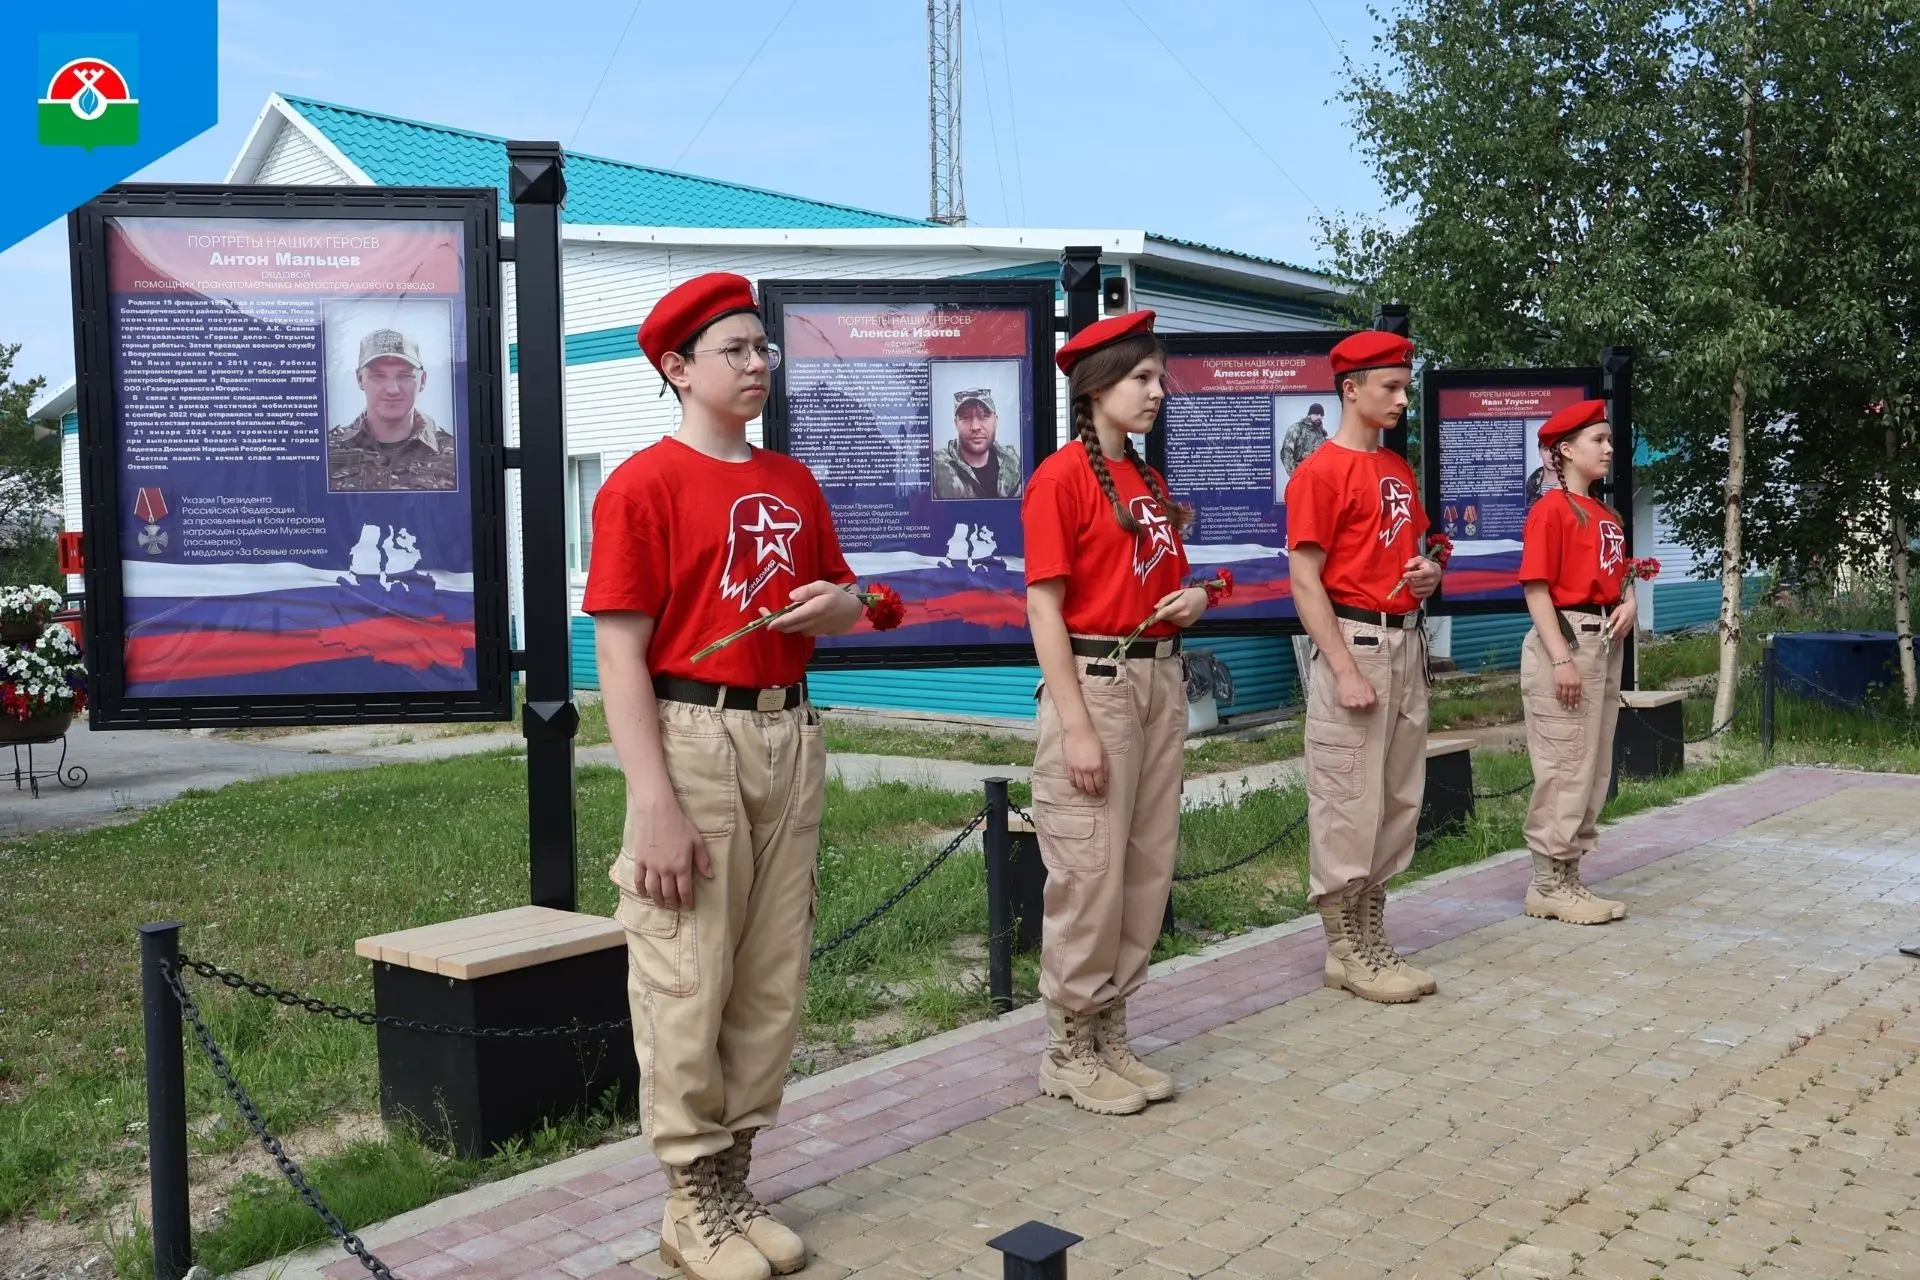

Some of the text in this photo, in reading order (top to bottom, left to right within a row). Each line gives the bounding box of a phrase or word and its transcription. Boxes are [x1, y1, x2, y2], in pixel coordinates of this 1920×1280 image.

[188, 235, 379, 249] ПОРТРЕТЫ НАШИХ ГЕРОЕВ
[210, 252, 360, 268] Антон Мальцев
[261, 270, 311, 281] рядовой
[134, 280, 435, 290] помощник гранатометчика мотострелкового взвода
[892, 316, 931, 325] НАШИХ
[934, 315, 971, 325] ГЕРОЕВ
[850, 327, 960, 338] Алексей Изотов
[1213, 369, 1296, 378] Алексей Кушев
[216, 496, 272, 505] Президента
[182, 506, 295, 515] Российской Федерации
[195, 517, 255, 526] проявленный
[287, 517, 325, 525] героизм
[280, 527, 326, 536] Мужества
[183, 538, 242, 547] (посмертно)
